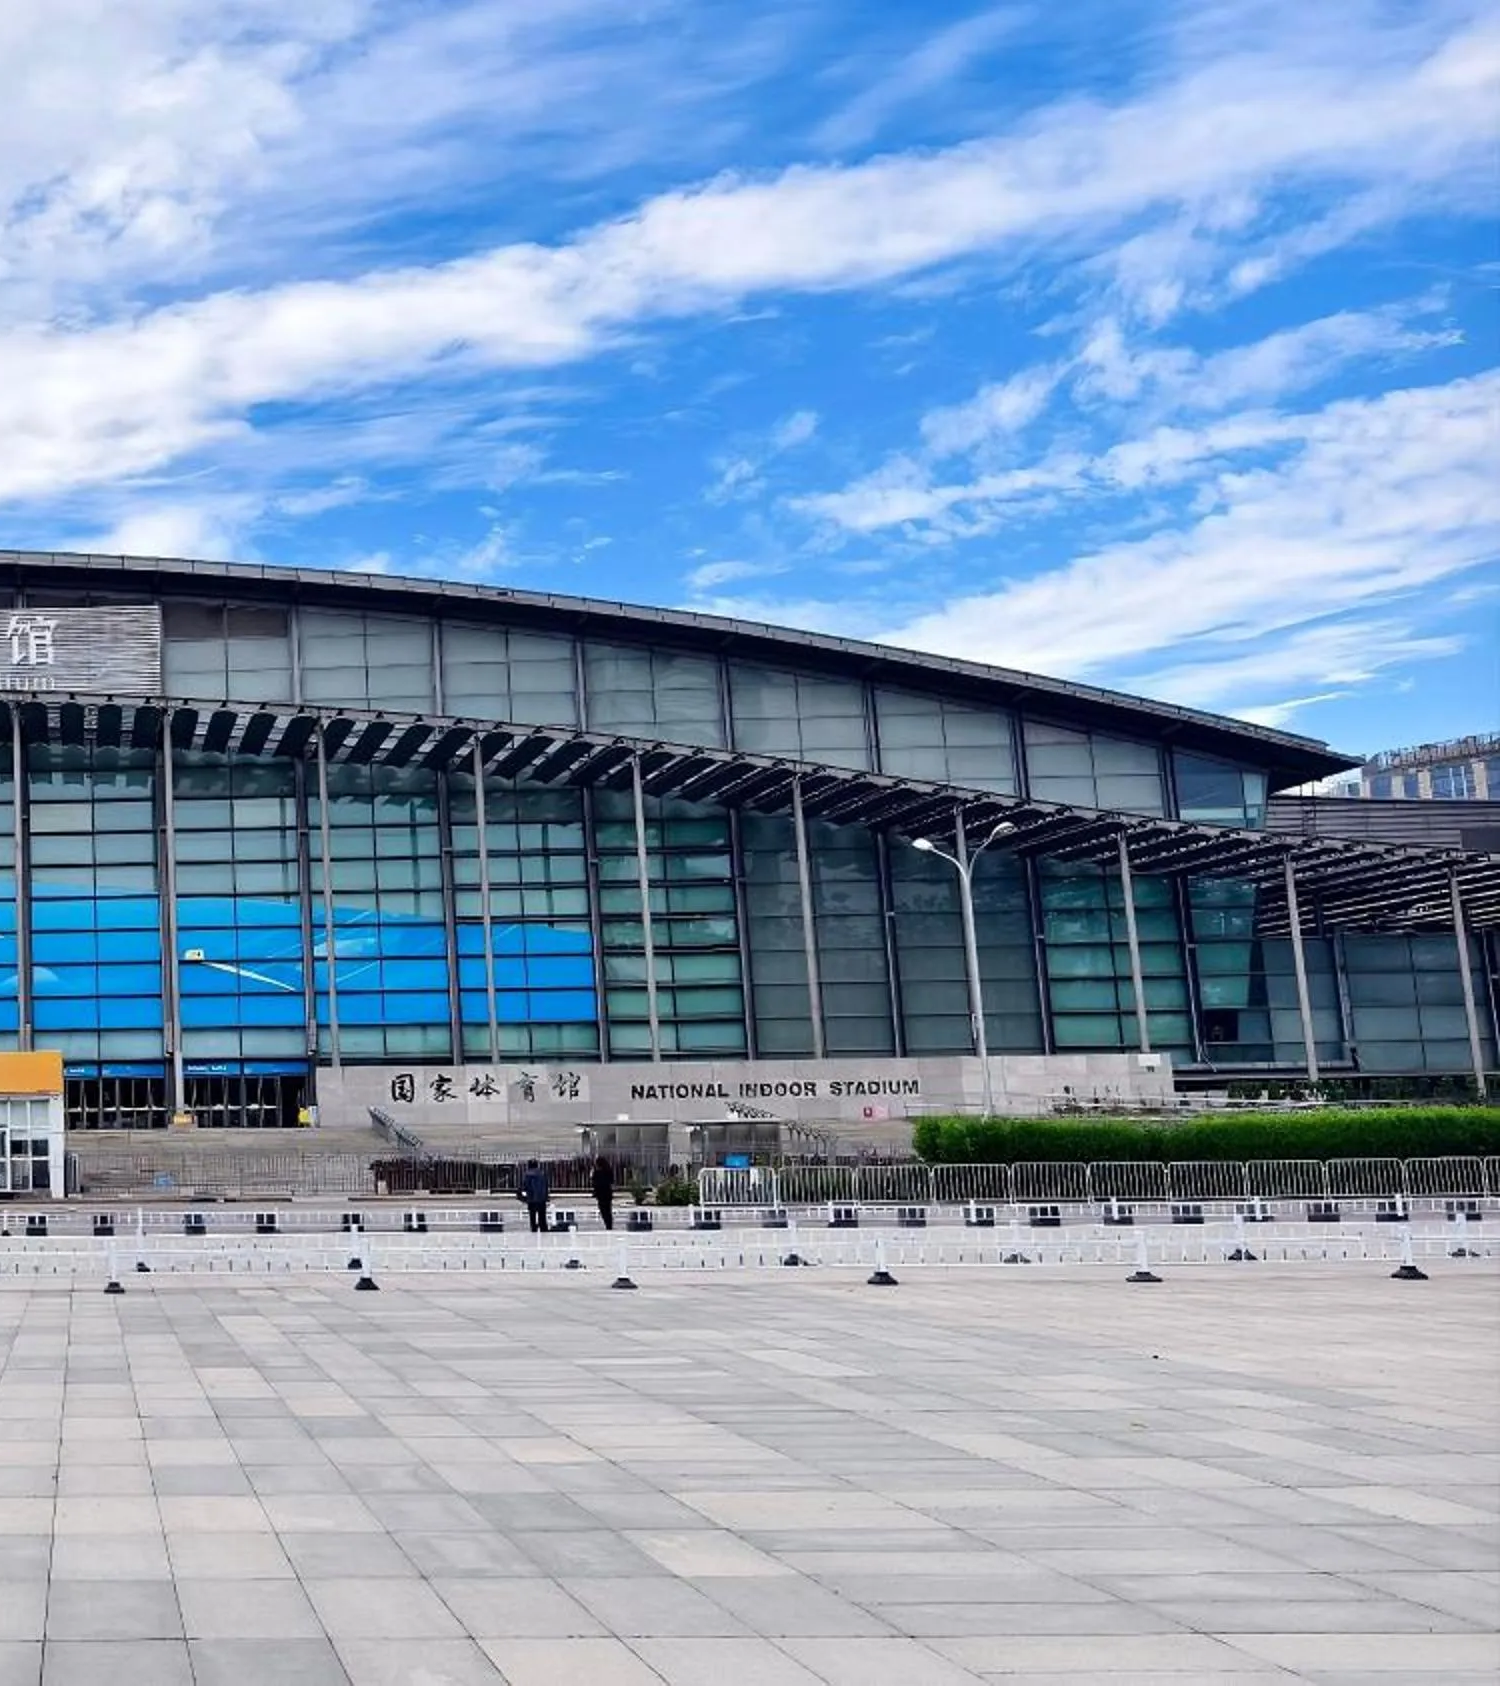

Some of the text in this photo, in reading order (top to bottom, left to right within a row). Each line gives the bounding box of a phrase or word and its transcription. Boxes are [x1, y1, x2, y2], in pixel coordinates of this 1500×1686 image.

[391, 1071, 581, 1103] 国家体育馆
[631, 1079, 920, 1099] NATIONAL INDOOR STADIUM
